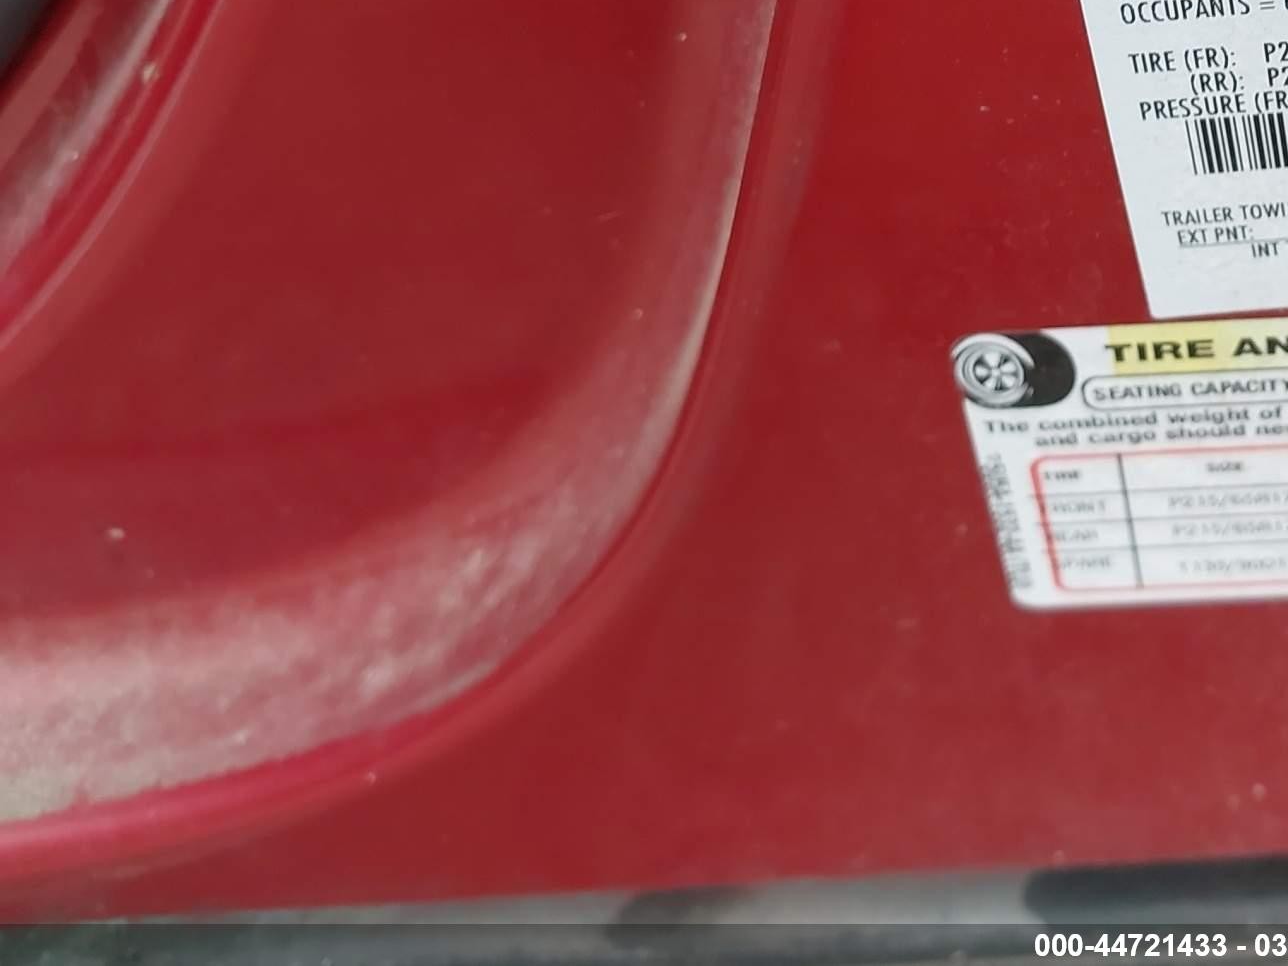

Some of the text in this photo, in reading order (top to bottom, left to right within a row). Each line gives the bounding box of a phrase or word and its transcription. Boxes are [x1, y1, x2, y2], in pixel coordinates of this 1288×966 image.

[1128, 51, 1175, 75] TIRE
[1184, 46, 1237, 70] (FR):
[1190, 71, 1245, 95] (RR):
[1138, 93, 1246, 121] PRESSURE
[1161, 206, 1233, 227] TRAILER
[1177, 229, 1207, 246] EXT
[1214, 225, 1253, 242] PNT:
[1251, 242, 1279, 258] INT
[1106, 338, 1216, 363] TIRE
[1093, 382, 1181, 401] SEATING
[983, 418, 1028, 434] The
[1039, 412, 1157, 431] combined
[1168, 407, 1250, 429] weight
[1259, 405, 1284, 420] of
[1035, 432, 1078, 447] and
[1088, 428, 1157, 448] cargo
[1166, 422, 1246, 440] should
